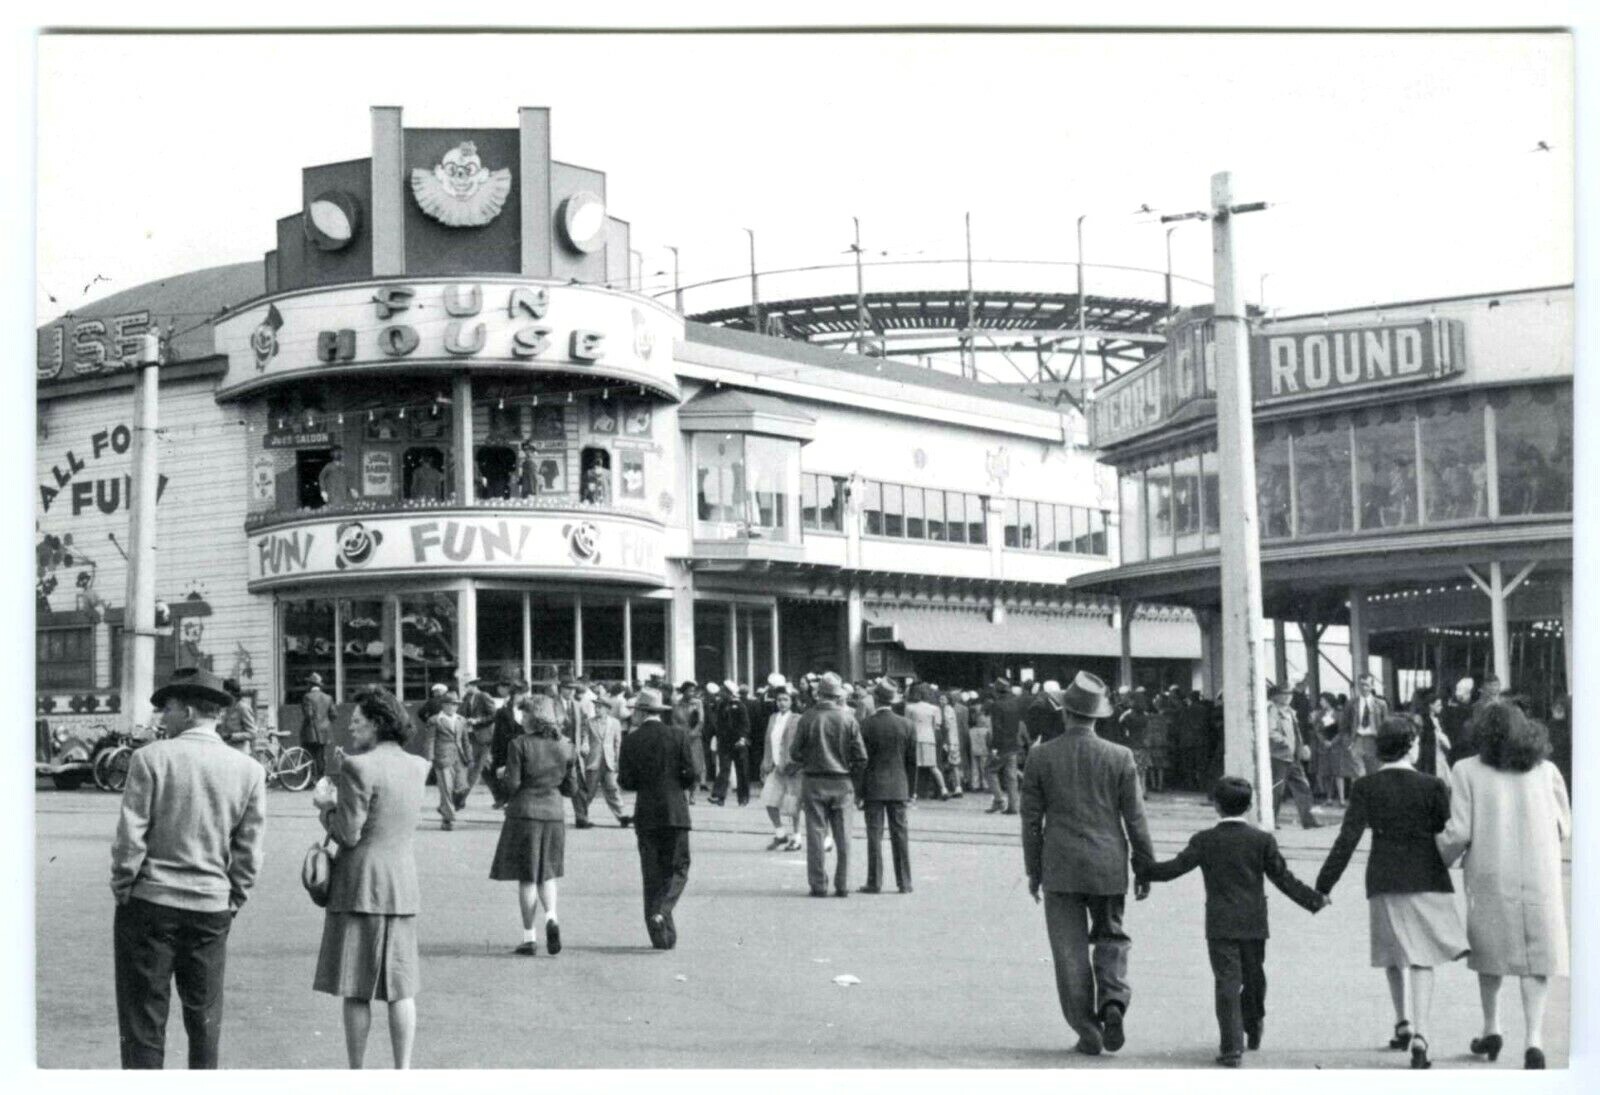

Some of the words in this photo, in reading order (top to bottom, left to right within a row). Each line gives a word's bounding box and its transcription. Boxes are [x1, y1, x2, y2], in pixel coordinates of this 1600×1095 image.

[375, 284, 550, 320] FUN
[317, 322, 606, 365] HOUSE
[1269, 327, 1424, 396] ROUND
[40, 450, 85, 514] ALL
[92, 424, 131, 460] FO
[258, 531, 315, 577] FUN!
[410, 521, 532, 563] FUN!
